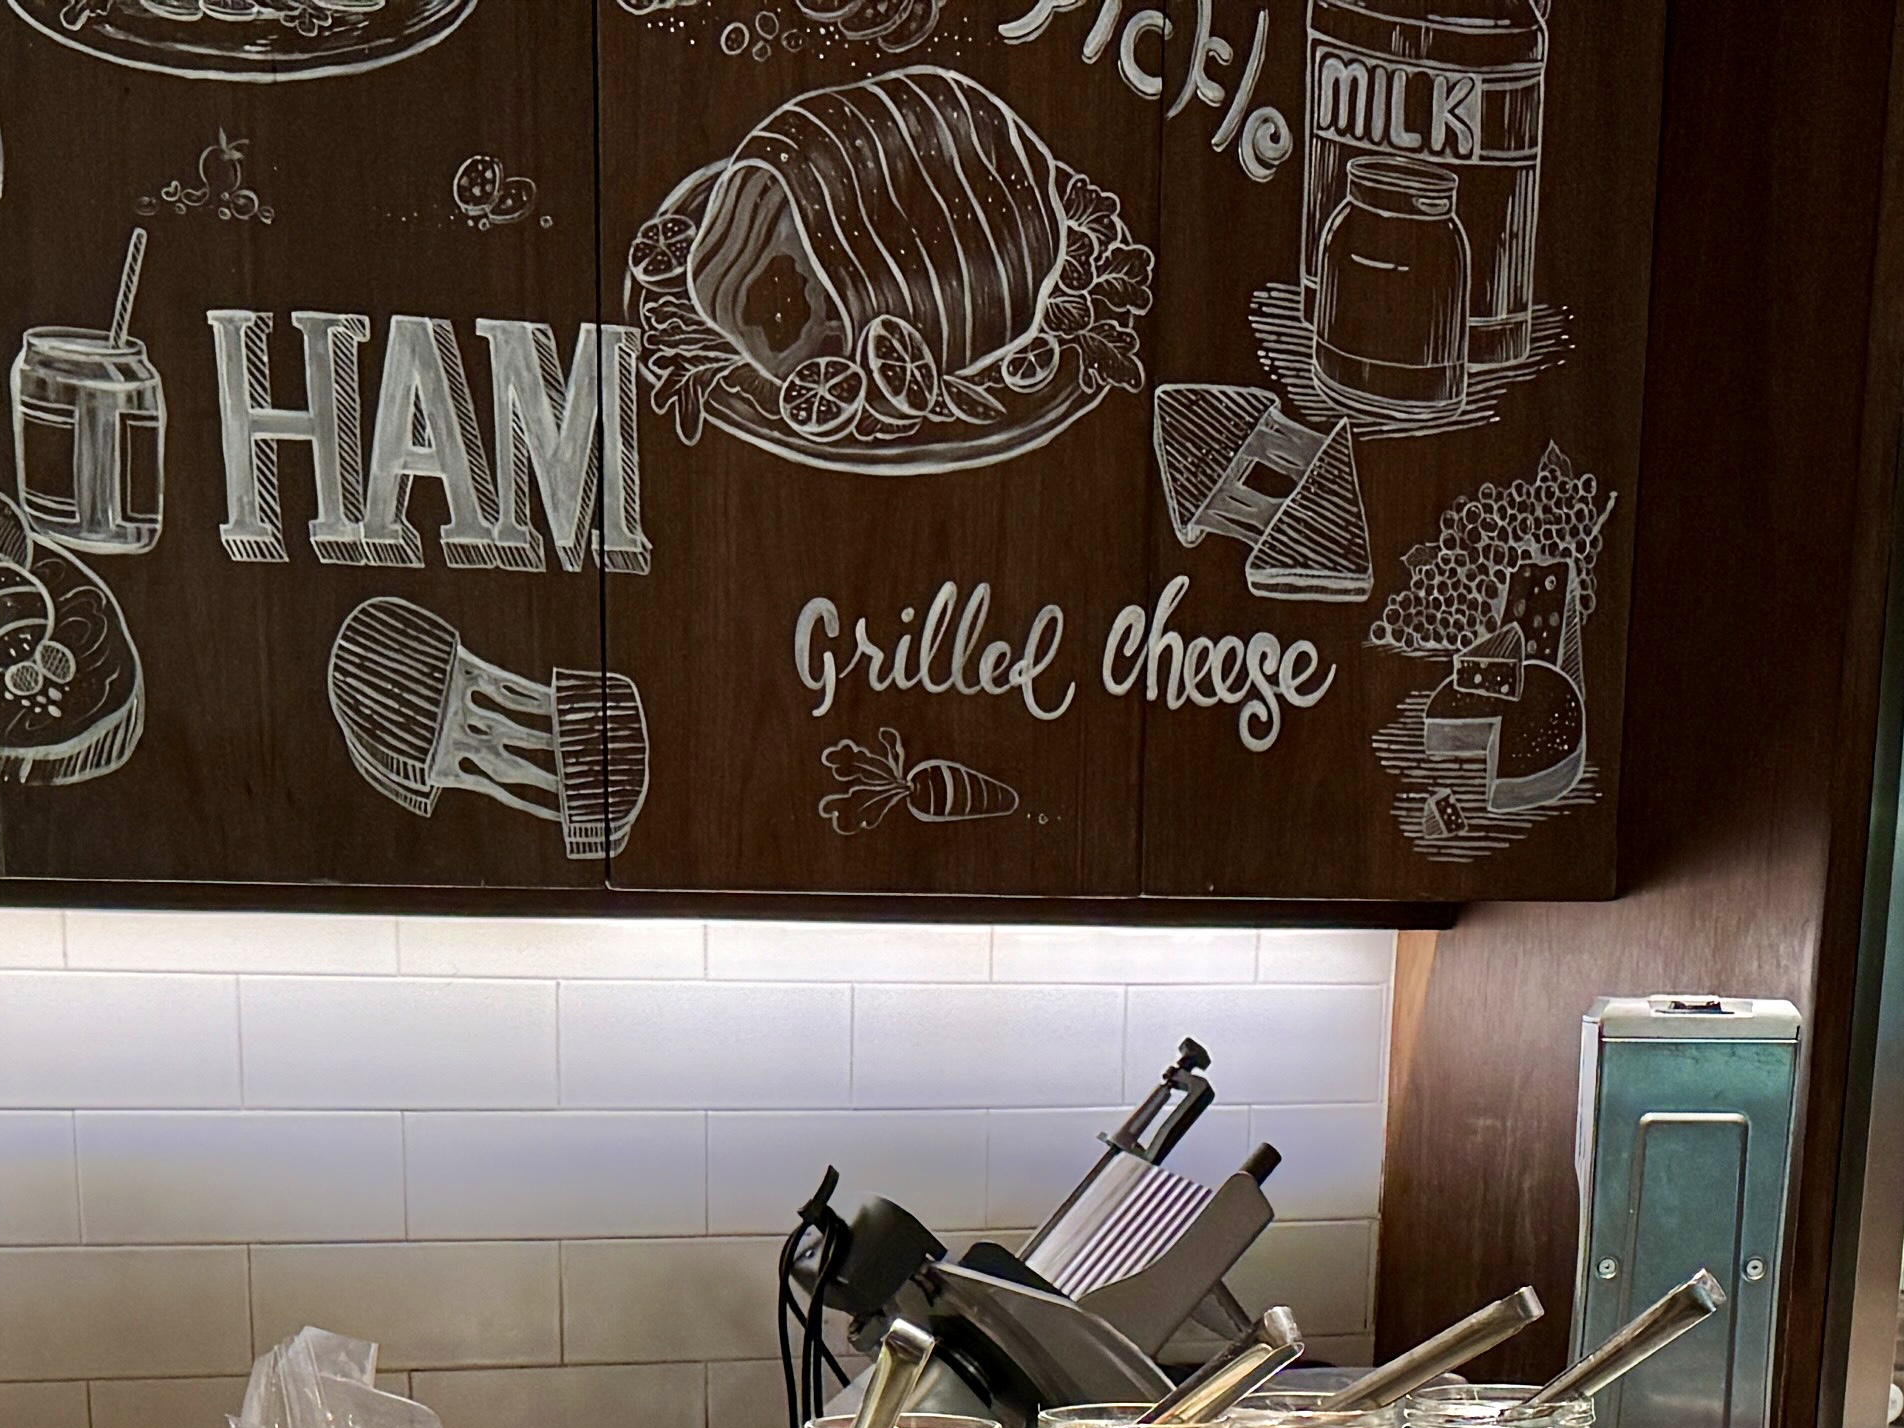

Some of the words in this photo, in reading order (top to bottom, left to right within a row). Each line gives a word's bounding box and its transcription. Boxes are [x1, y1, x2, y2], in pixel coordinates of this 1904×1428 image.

[1319, 55, 1478, 157] MILK
[206, 309, 652, 575] HAM
[794, 580, 1077, 721] Grilled
